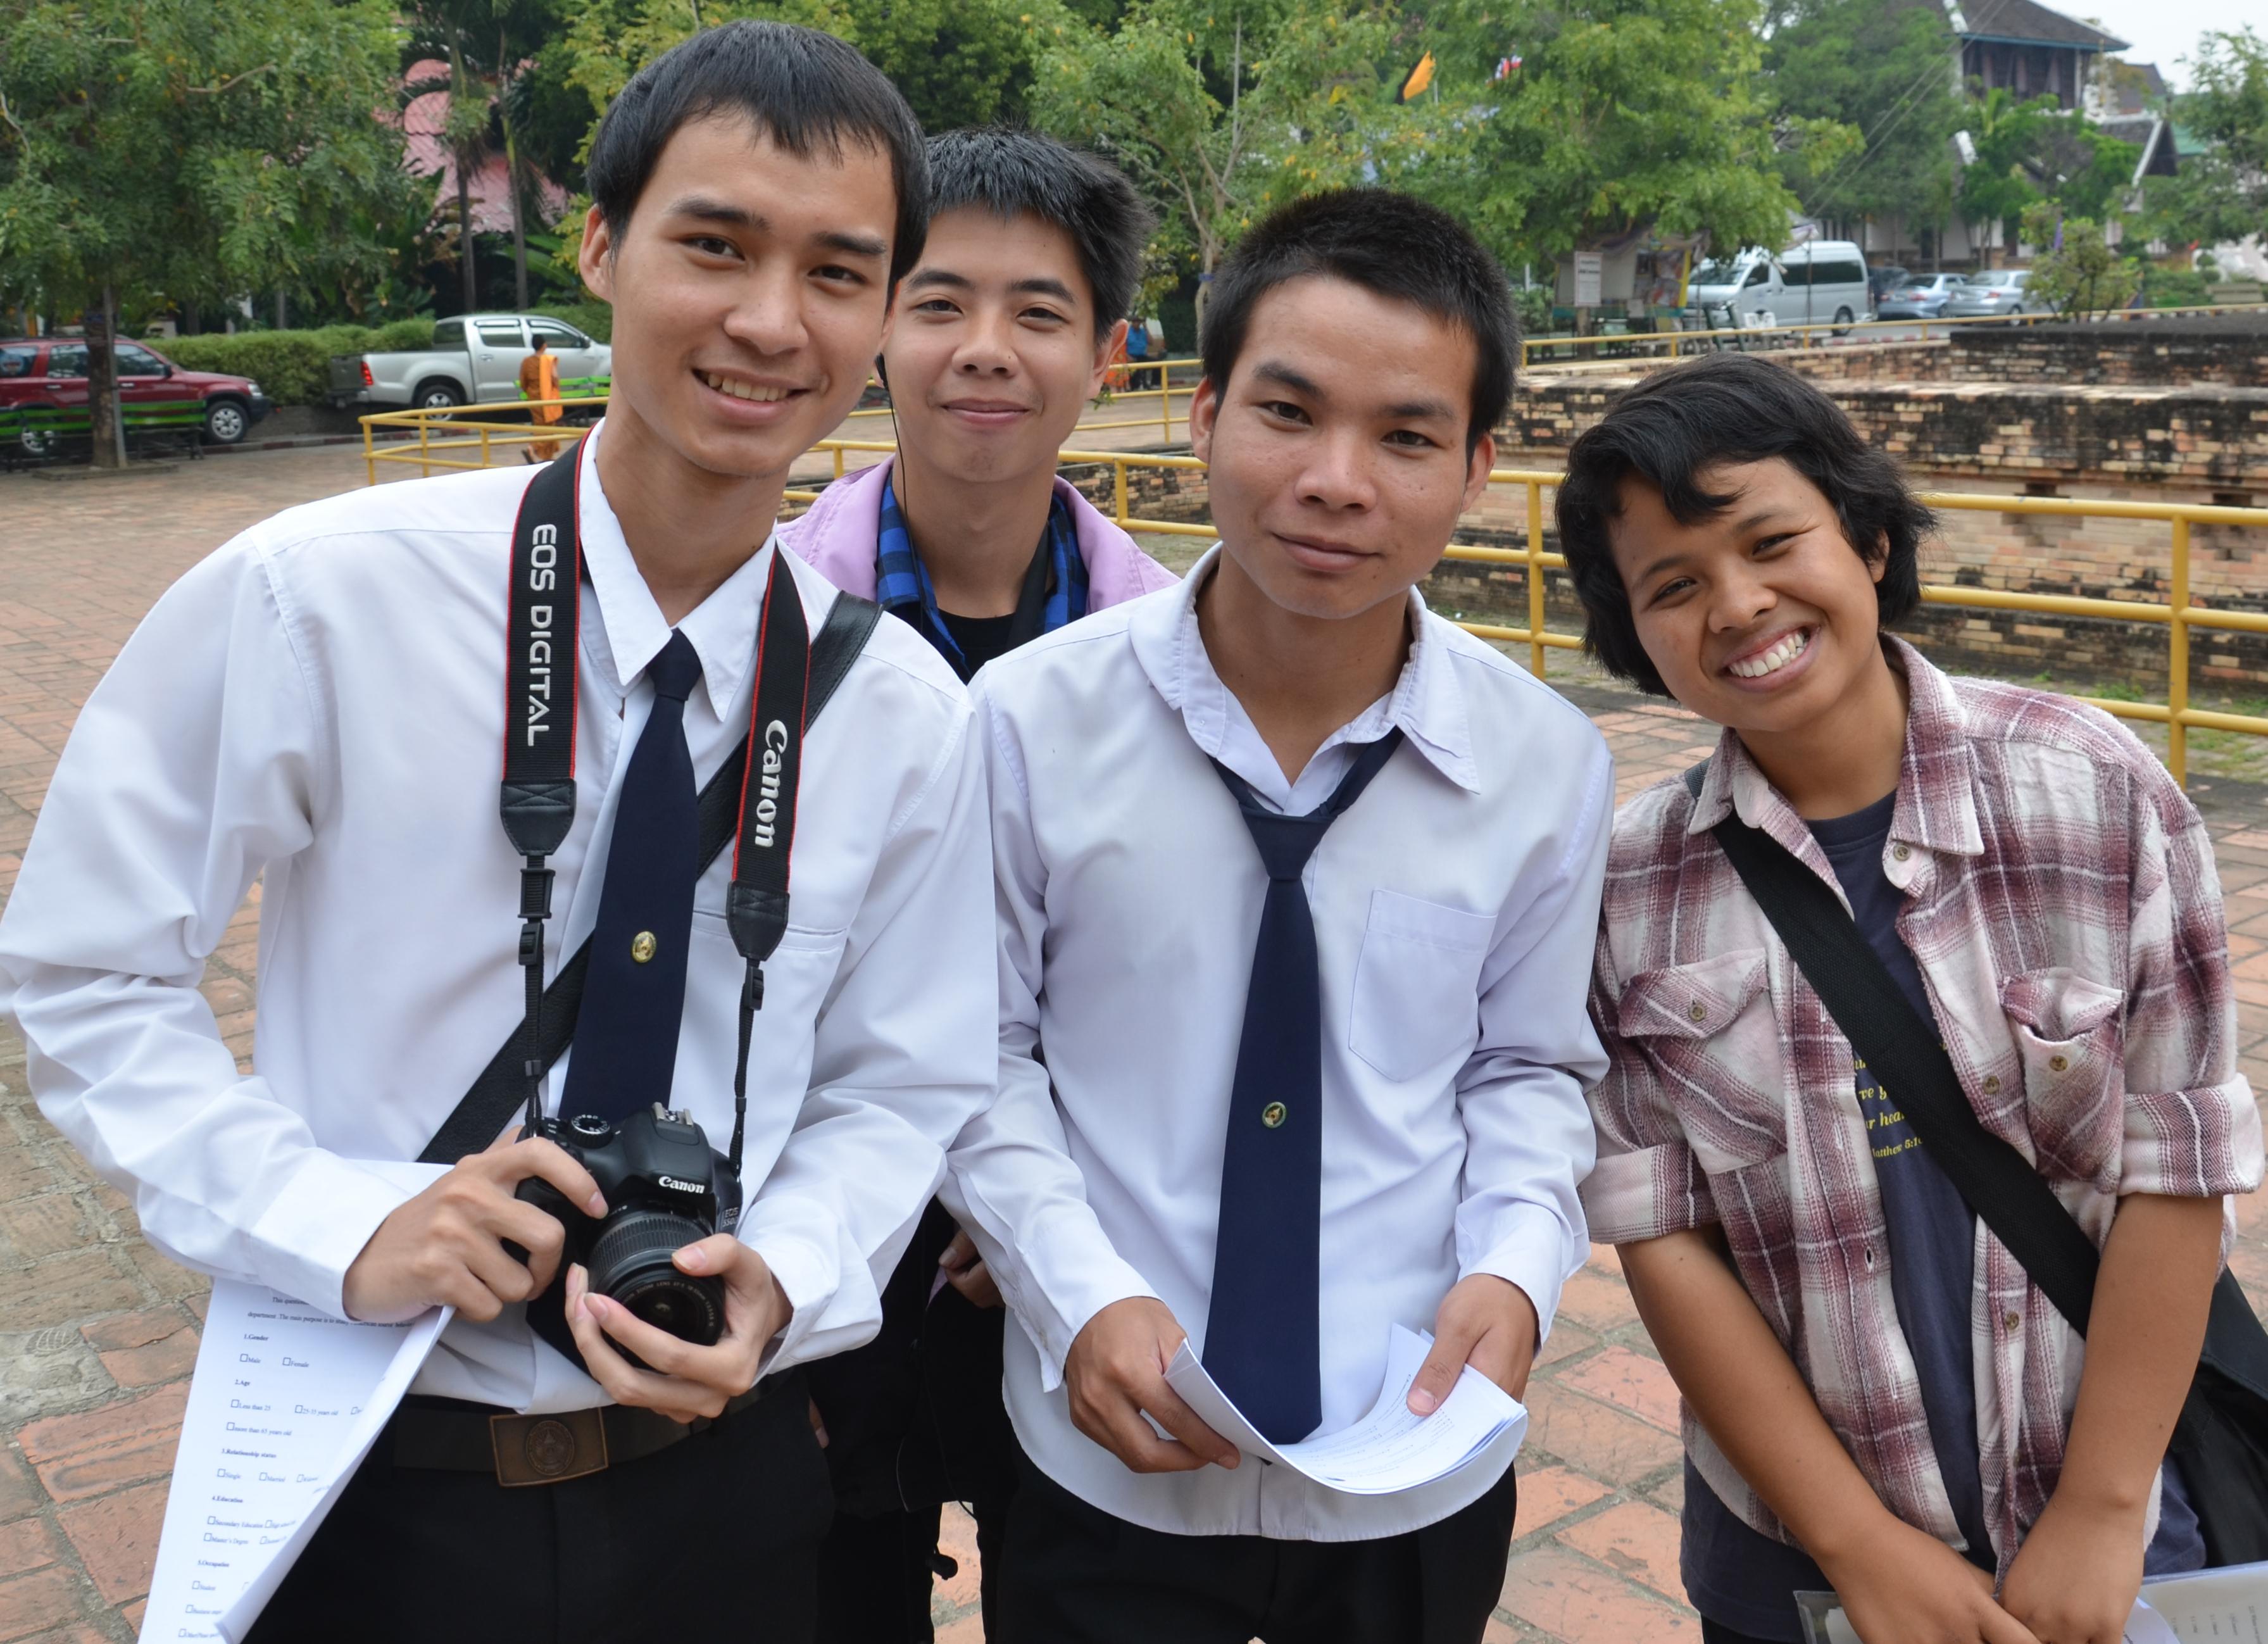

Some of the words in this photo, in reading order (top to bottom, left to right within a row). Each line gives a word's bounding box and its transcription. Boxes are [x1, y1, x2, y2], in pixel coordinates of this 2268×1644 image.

[530, 524, 557, 591] EOS
[527, 605, 553, 748] DIGITAL
[754, 719, 789, 848] Canon
[1858, 1088, 1874, 1100] ve
[1878, 1085, 1887, 1100] y
[658, 1176, 705, 1194] Canon
[243, 1333, 269, 1341] 1.Gender
